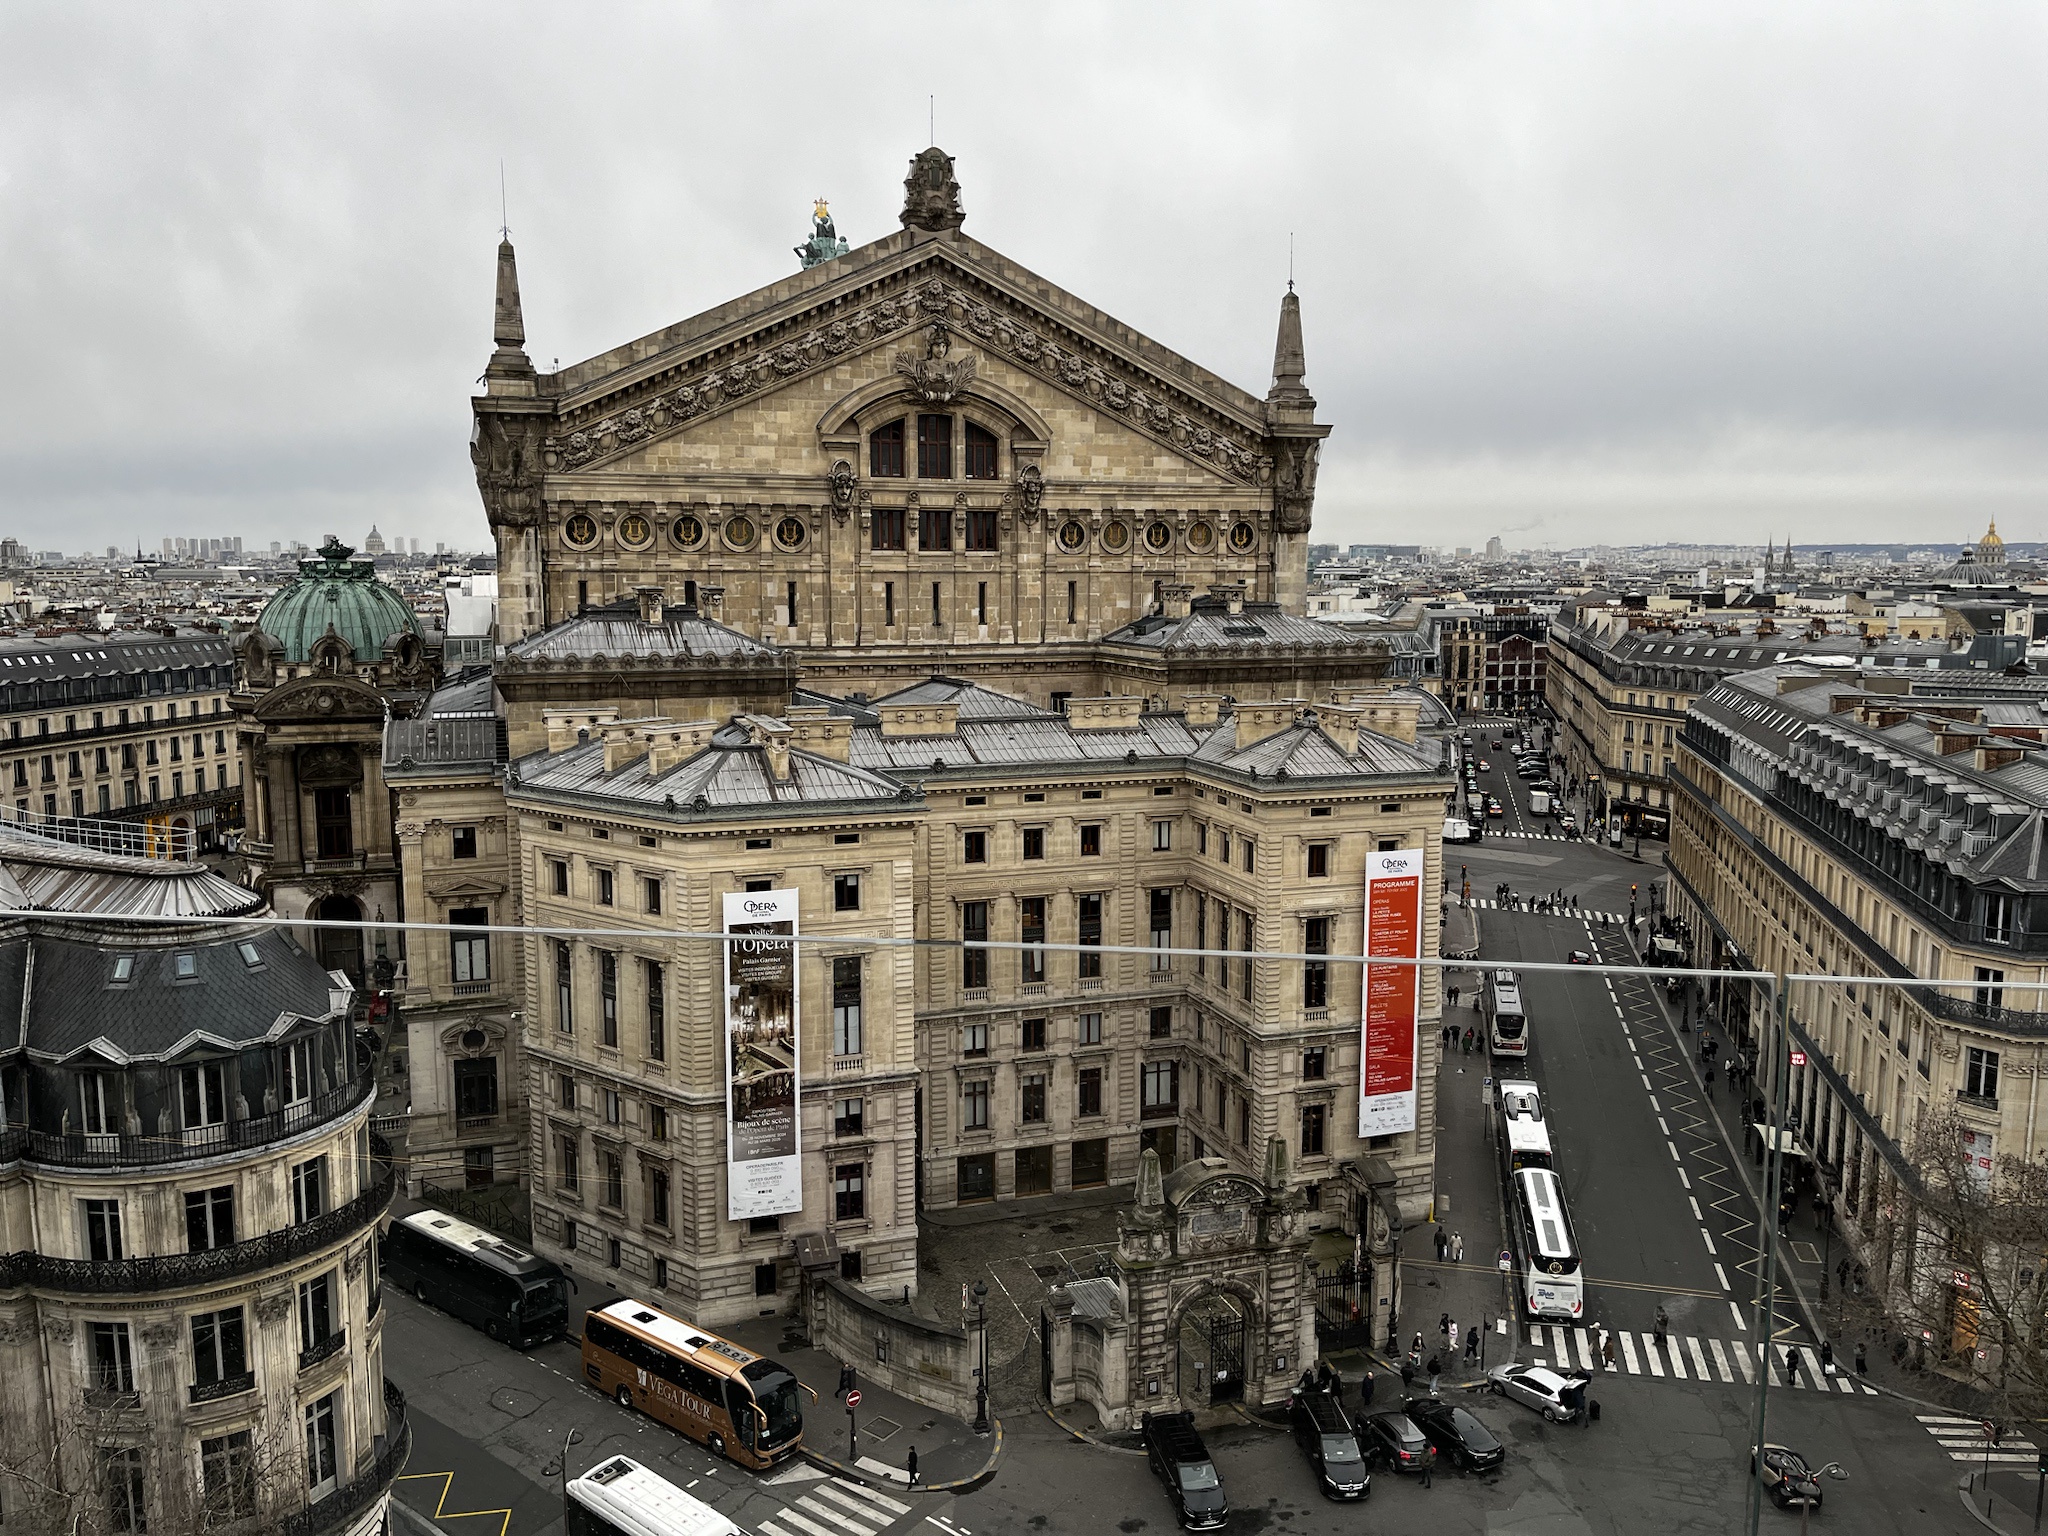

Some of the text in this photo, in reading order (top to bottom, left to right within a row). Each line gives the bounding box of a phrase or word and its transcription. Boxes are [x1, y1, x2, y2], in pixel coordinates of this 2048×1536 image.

[1373, 880, 1415, 889] PROGRAMME
[744, 900, 778, 913] OPÉRA
[748, 928, 774, 936] Visitez
[738, 1121, 760, 1129] Bijoux
[772, 1117, 791, 1125] scène
[680, 1390, 711, 1420] TOUR
